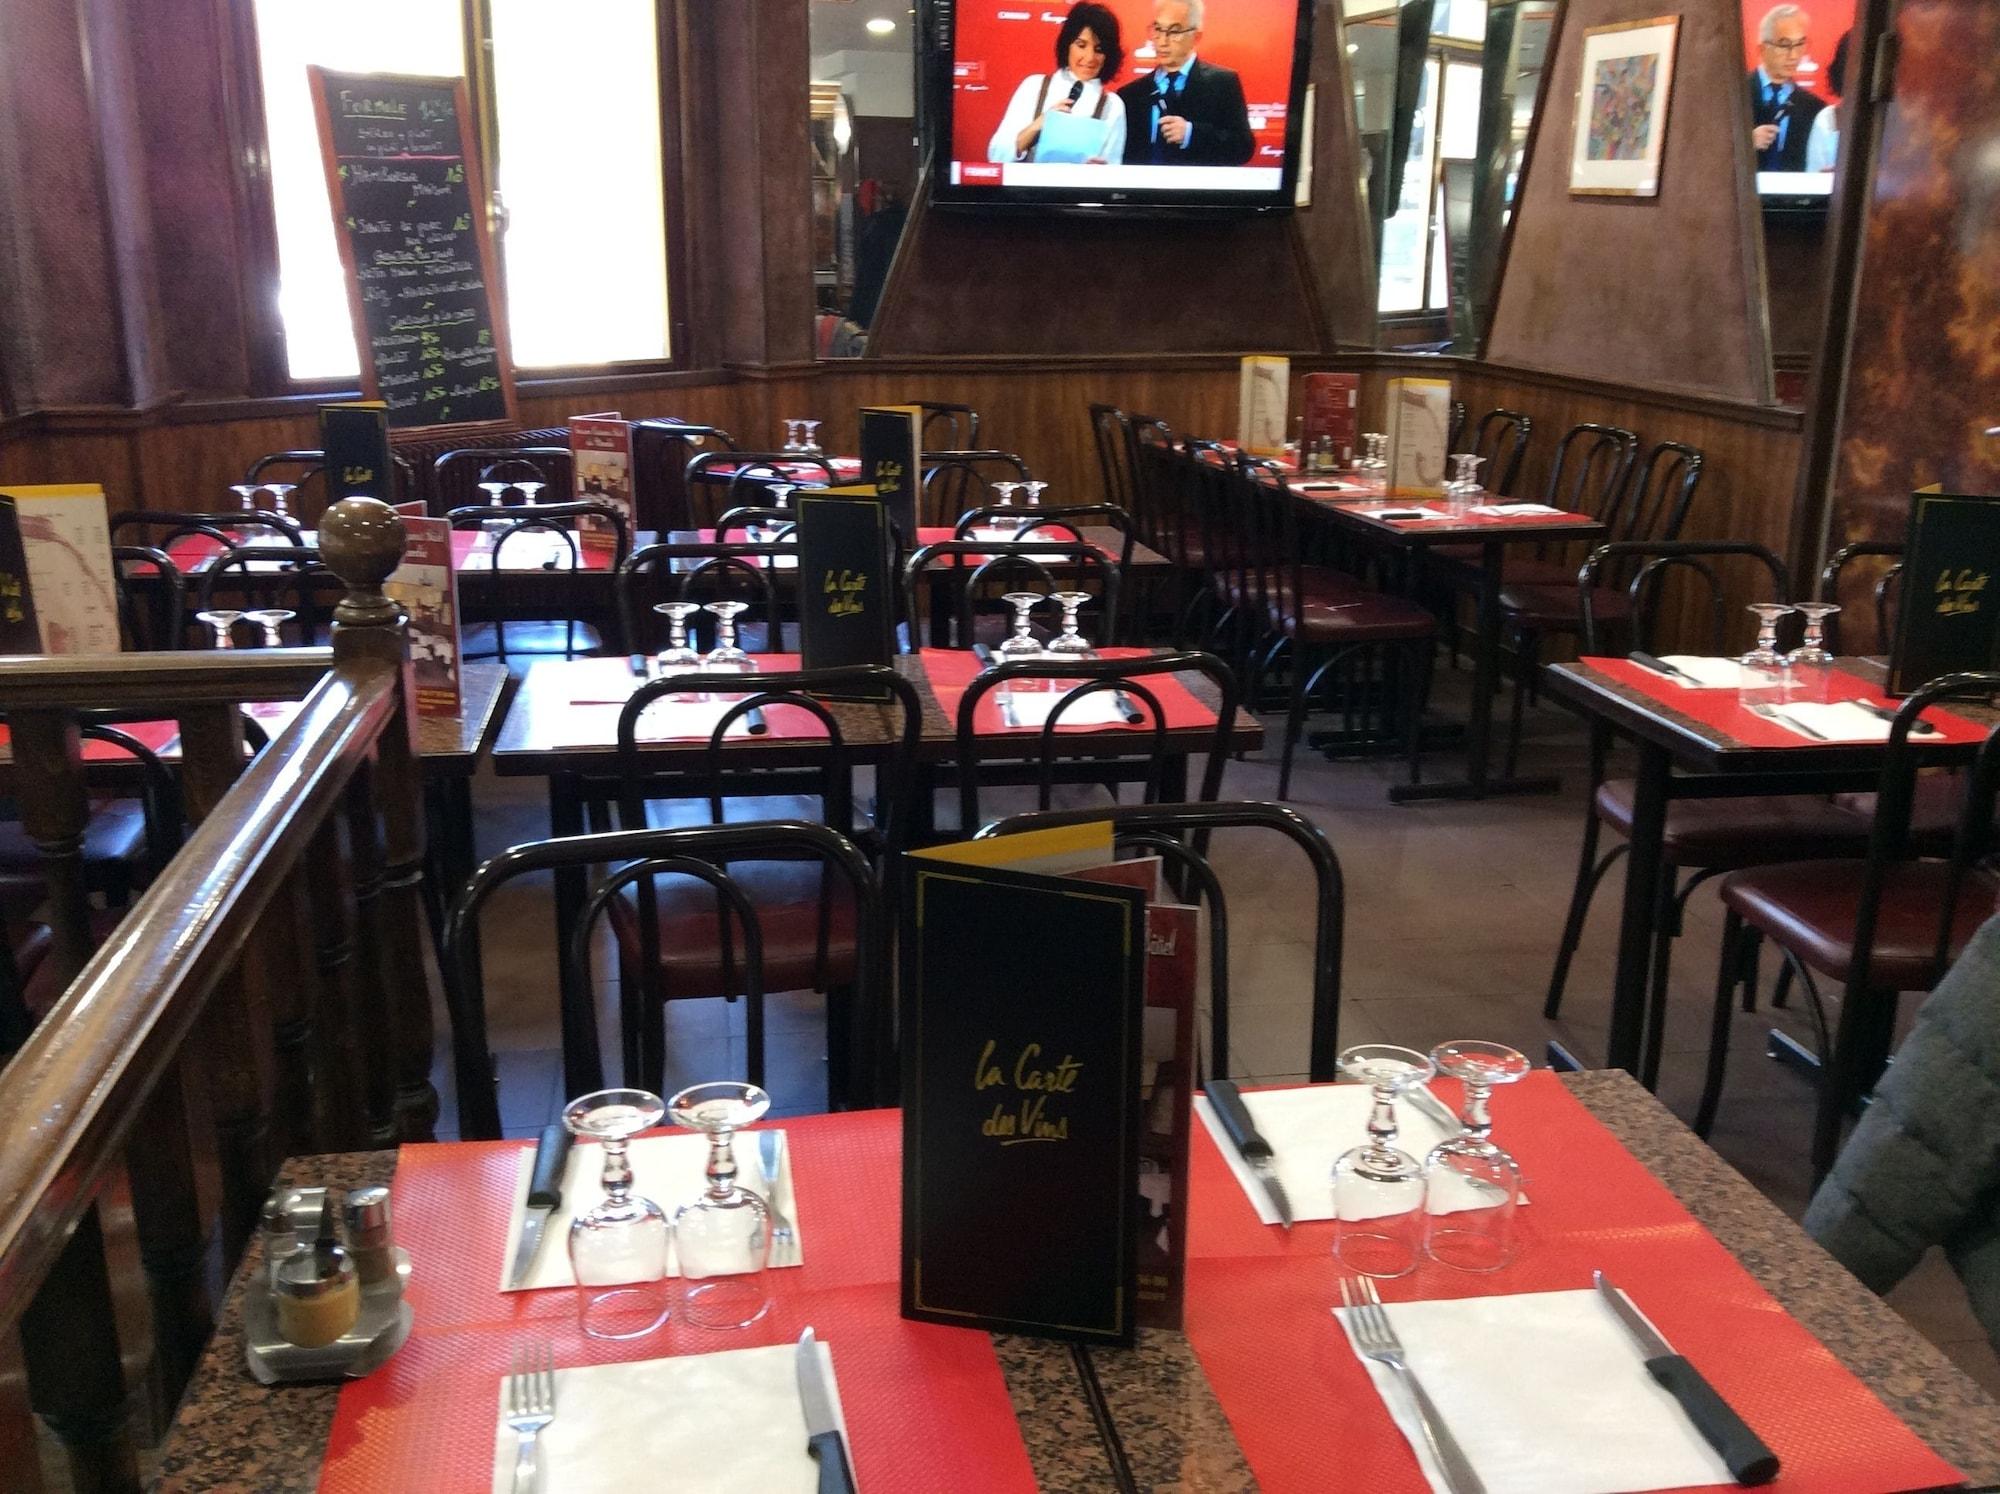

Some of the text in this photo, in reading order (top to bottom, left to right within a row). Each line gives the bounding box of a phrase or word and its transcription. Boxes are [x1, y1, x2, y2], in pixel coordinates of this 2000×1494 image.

[824, 569, 868, 593] La Carte
[1935, 568, 1991, 592] La Carte
[975, 1039, 1084, 1093] La Carte
[982, 1095, 1069, 1140] des Vins
